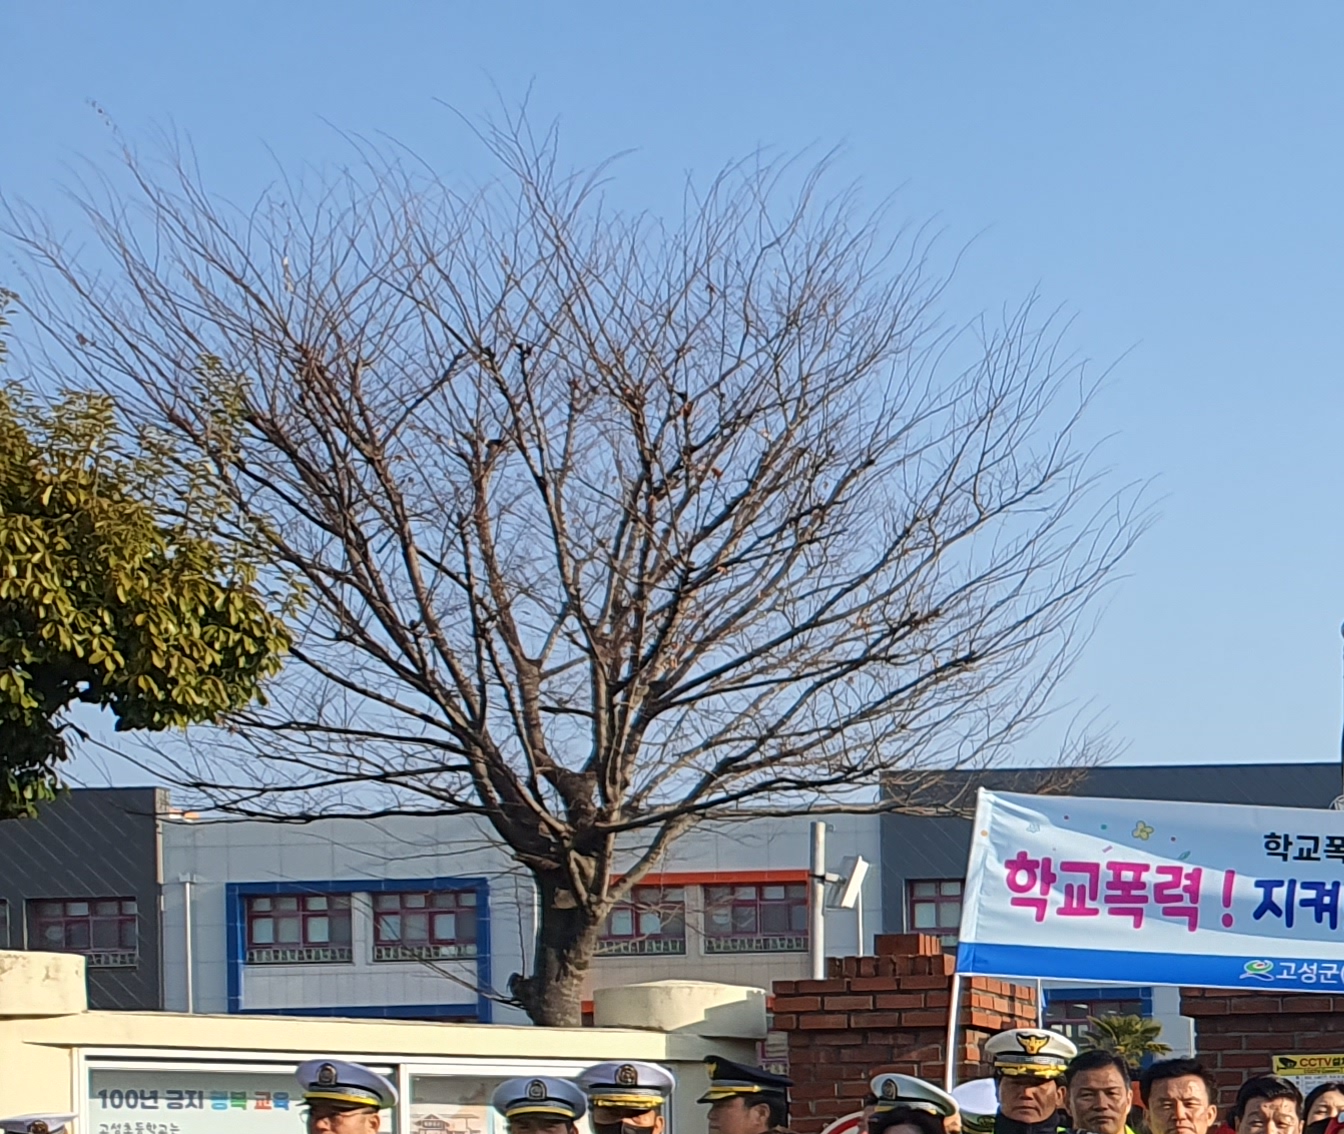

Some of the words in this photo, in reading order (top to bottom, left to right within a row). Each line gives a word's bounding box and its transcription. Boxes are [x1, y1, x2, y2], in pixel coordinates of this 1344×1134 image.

[1003, 850, 1203, 932] 학교폭력
[98, 1088, 160, 1110] 100년
[165, 1089, 204, 1110] 긍지
[209, 1090, 248, 1111] 행복
[253, 1090, 290, 1111] 교육
